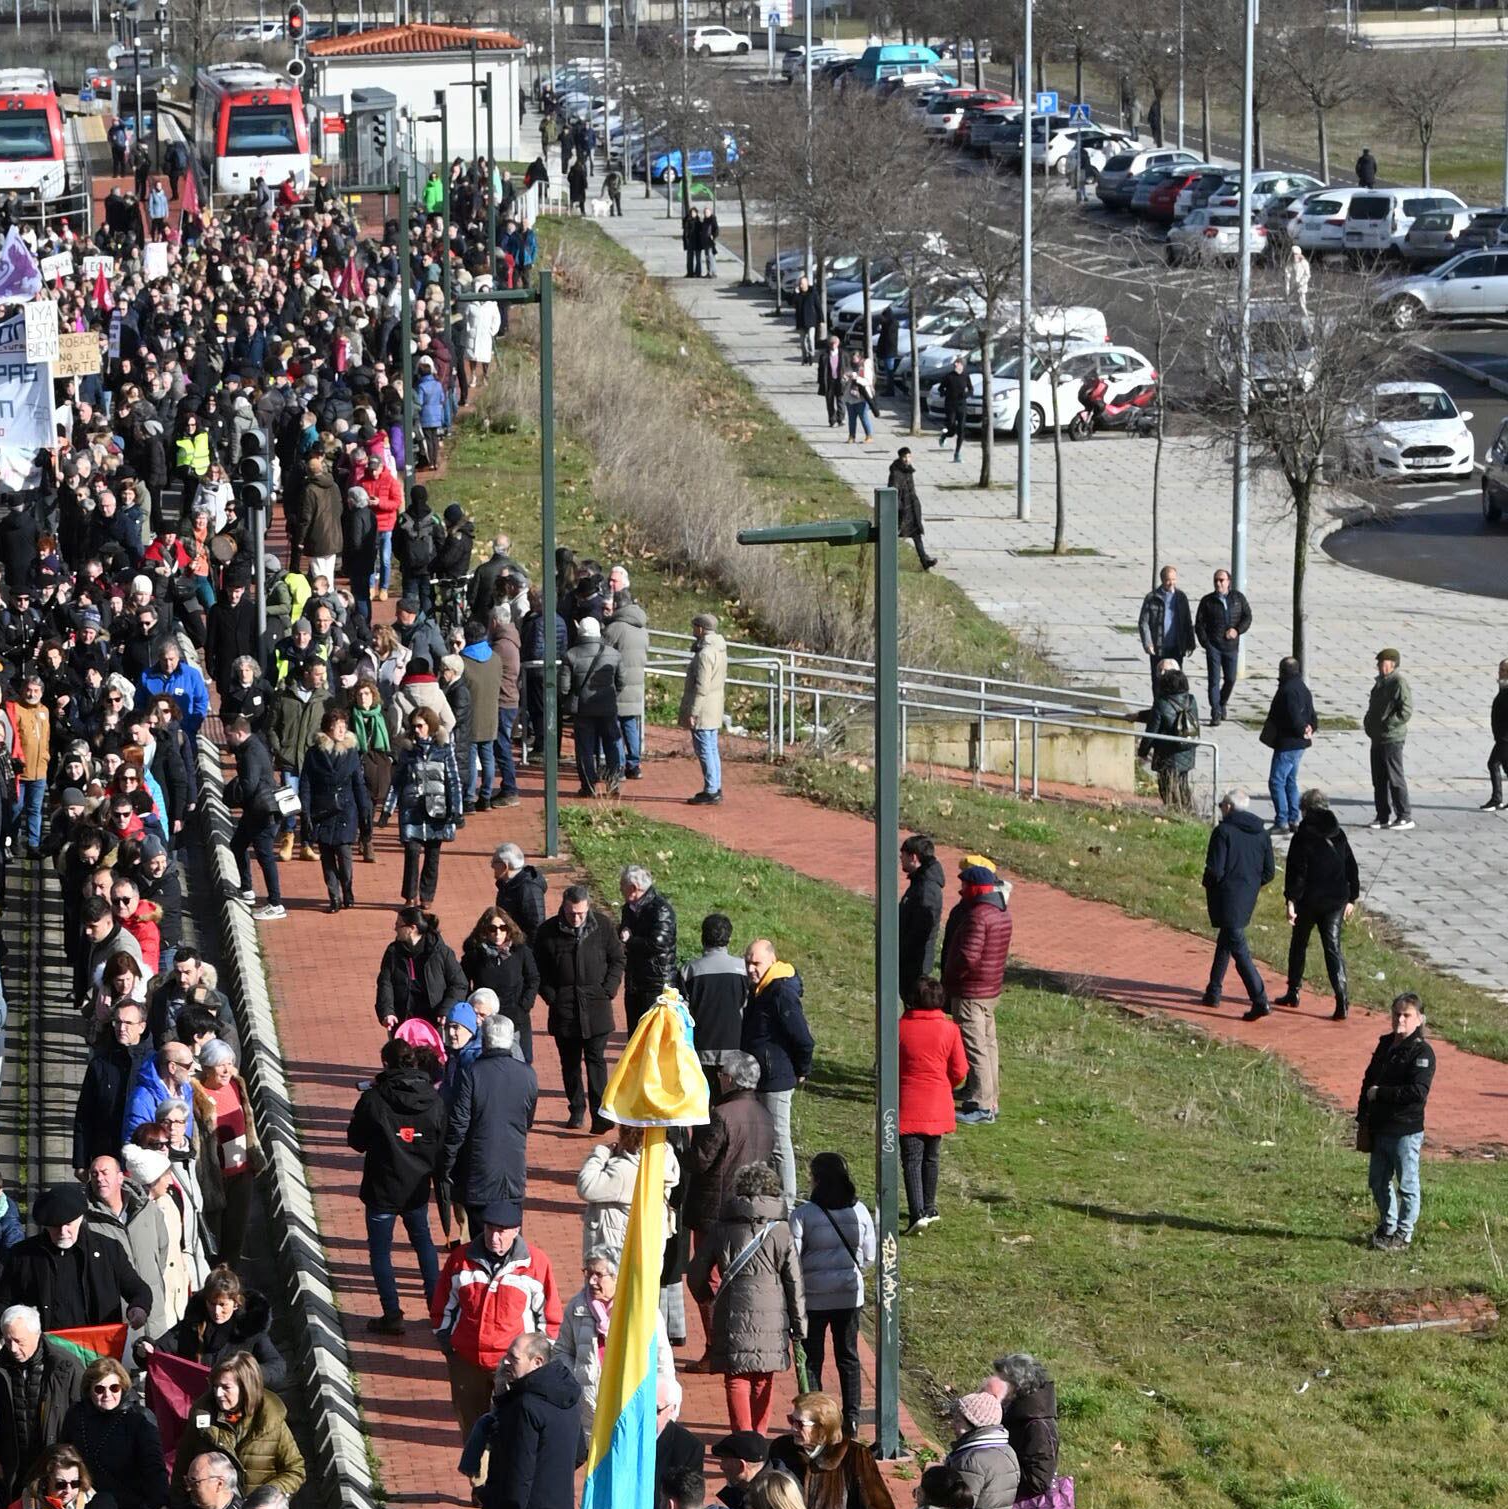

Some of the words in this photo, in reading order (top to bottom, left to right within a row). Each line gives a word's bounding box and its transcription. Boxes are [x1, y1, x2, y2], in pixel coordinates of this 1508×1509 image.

[1040, 95, 1053, 112] P
[59, 334, 99, 349] ROBAJO
[59, 353, 73, 362] NO
[79, 351, 92, 360] SE
[59, 360, 97, 375] PARTE
